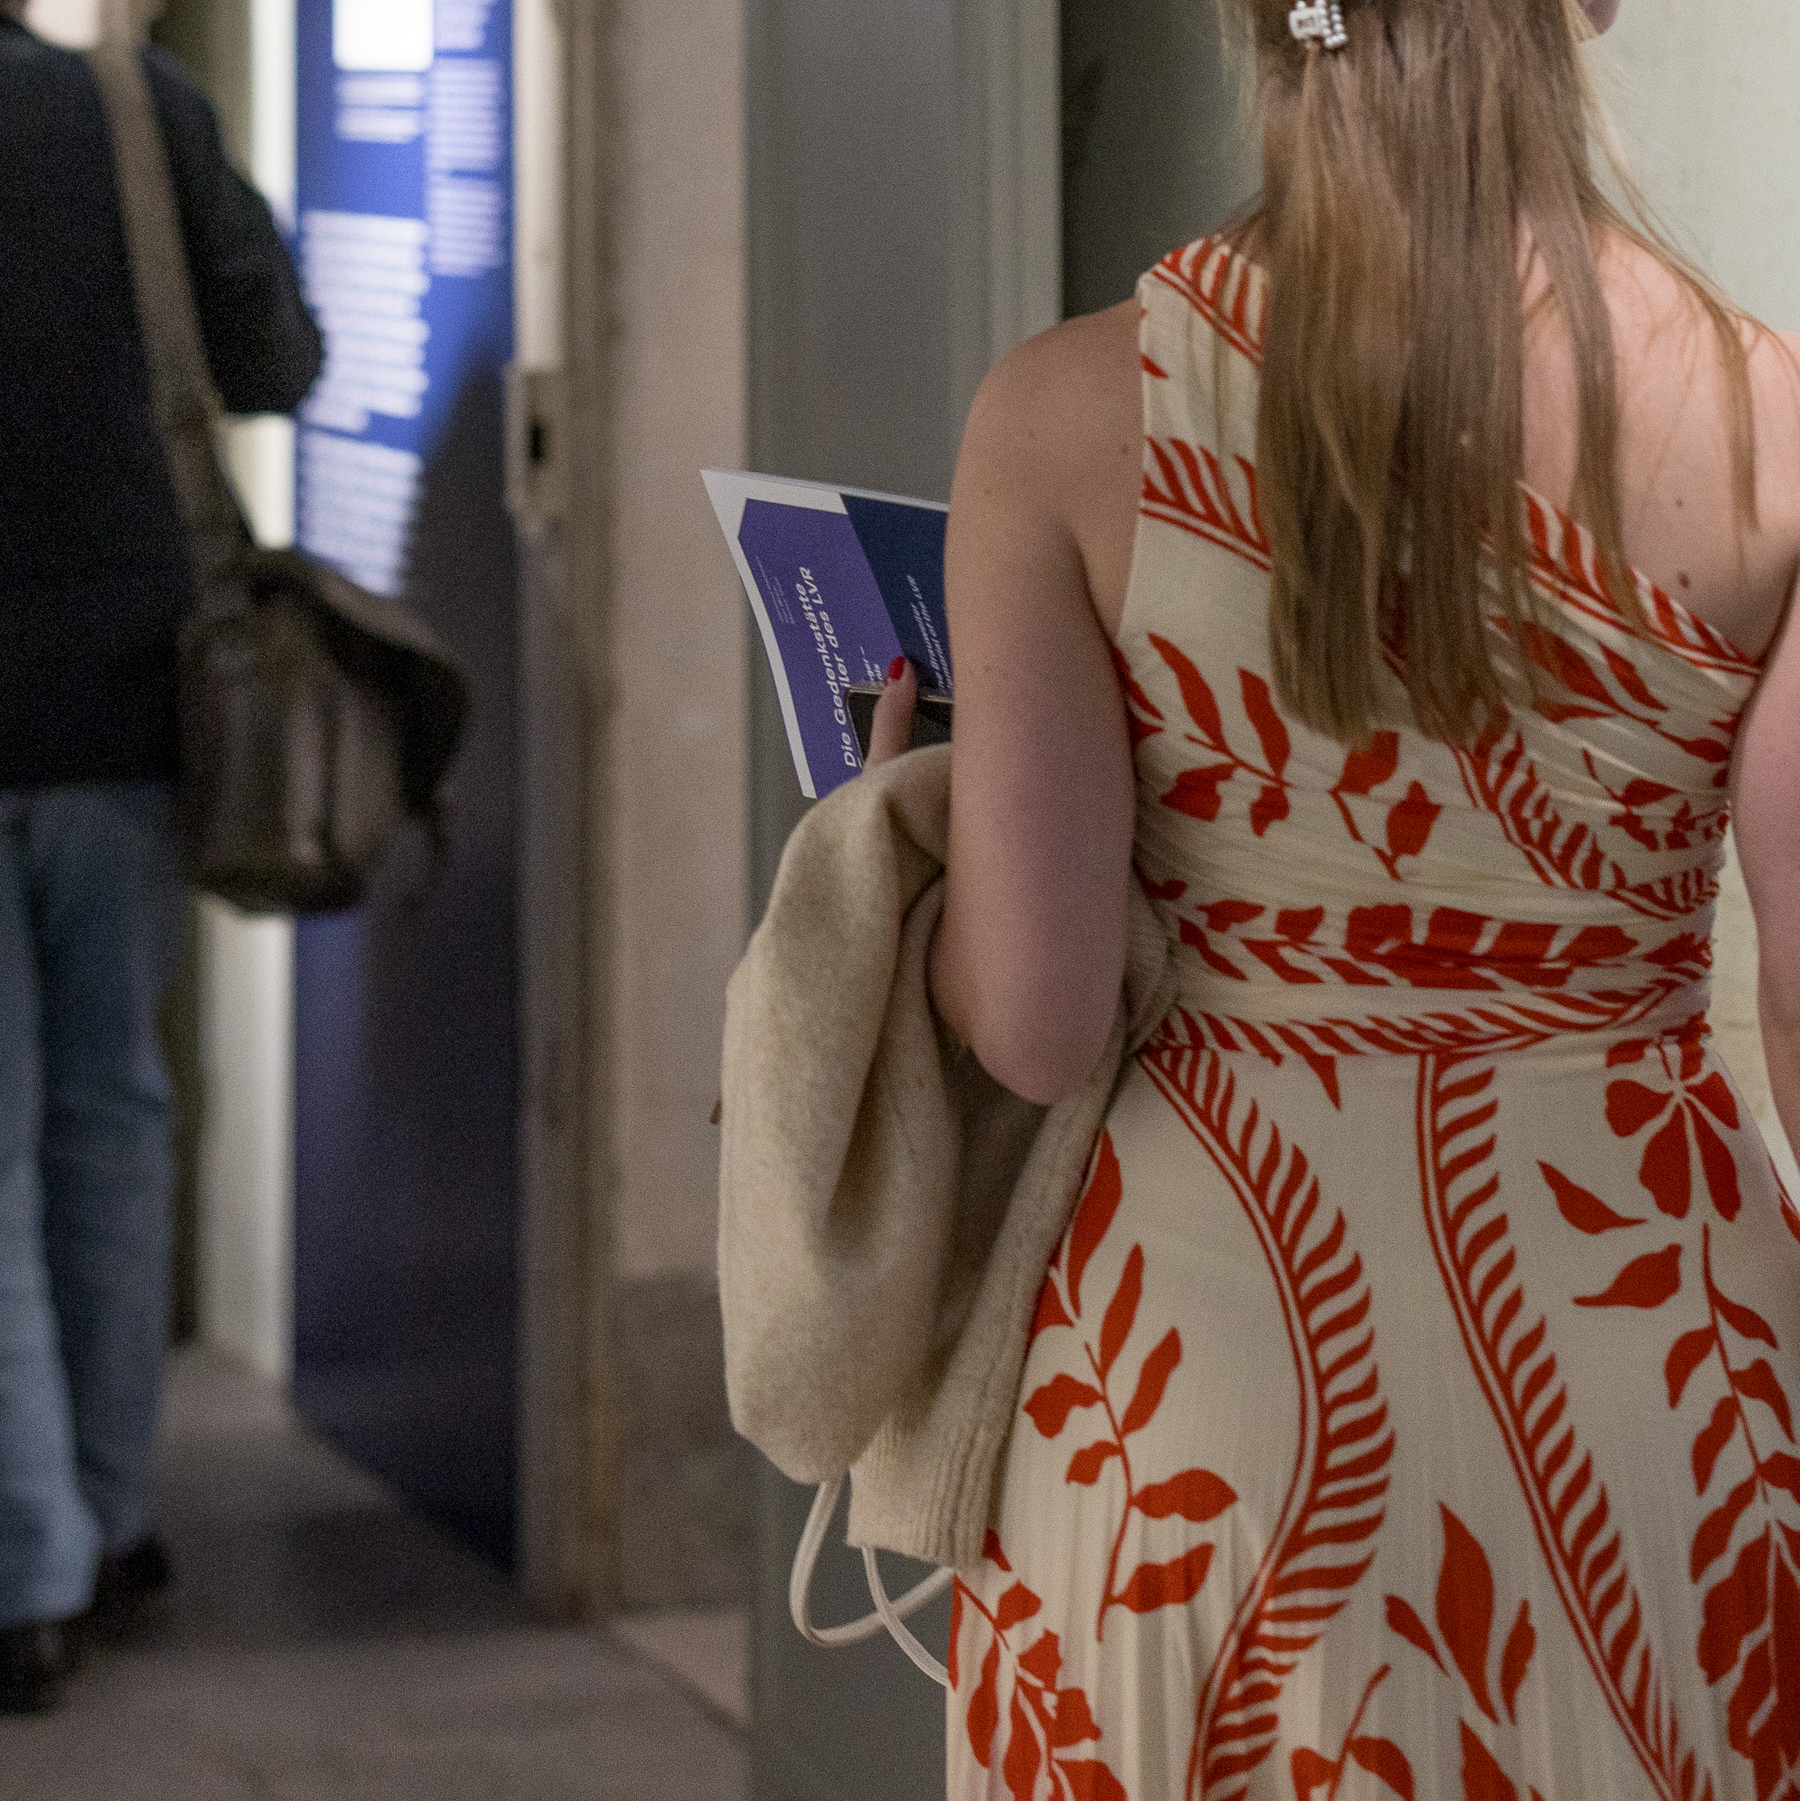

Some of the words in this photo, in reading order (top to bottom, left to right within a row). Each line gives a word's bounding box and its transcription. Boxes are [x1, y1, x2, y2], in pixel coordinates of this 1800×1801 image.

[799, 566, 824, 605] LVR
[819, 610, 839, 648] des
[795, 583, 848, 726] Gedenkstätte
[841, 731, 858, 768] Die
